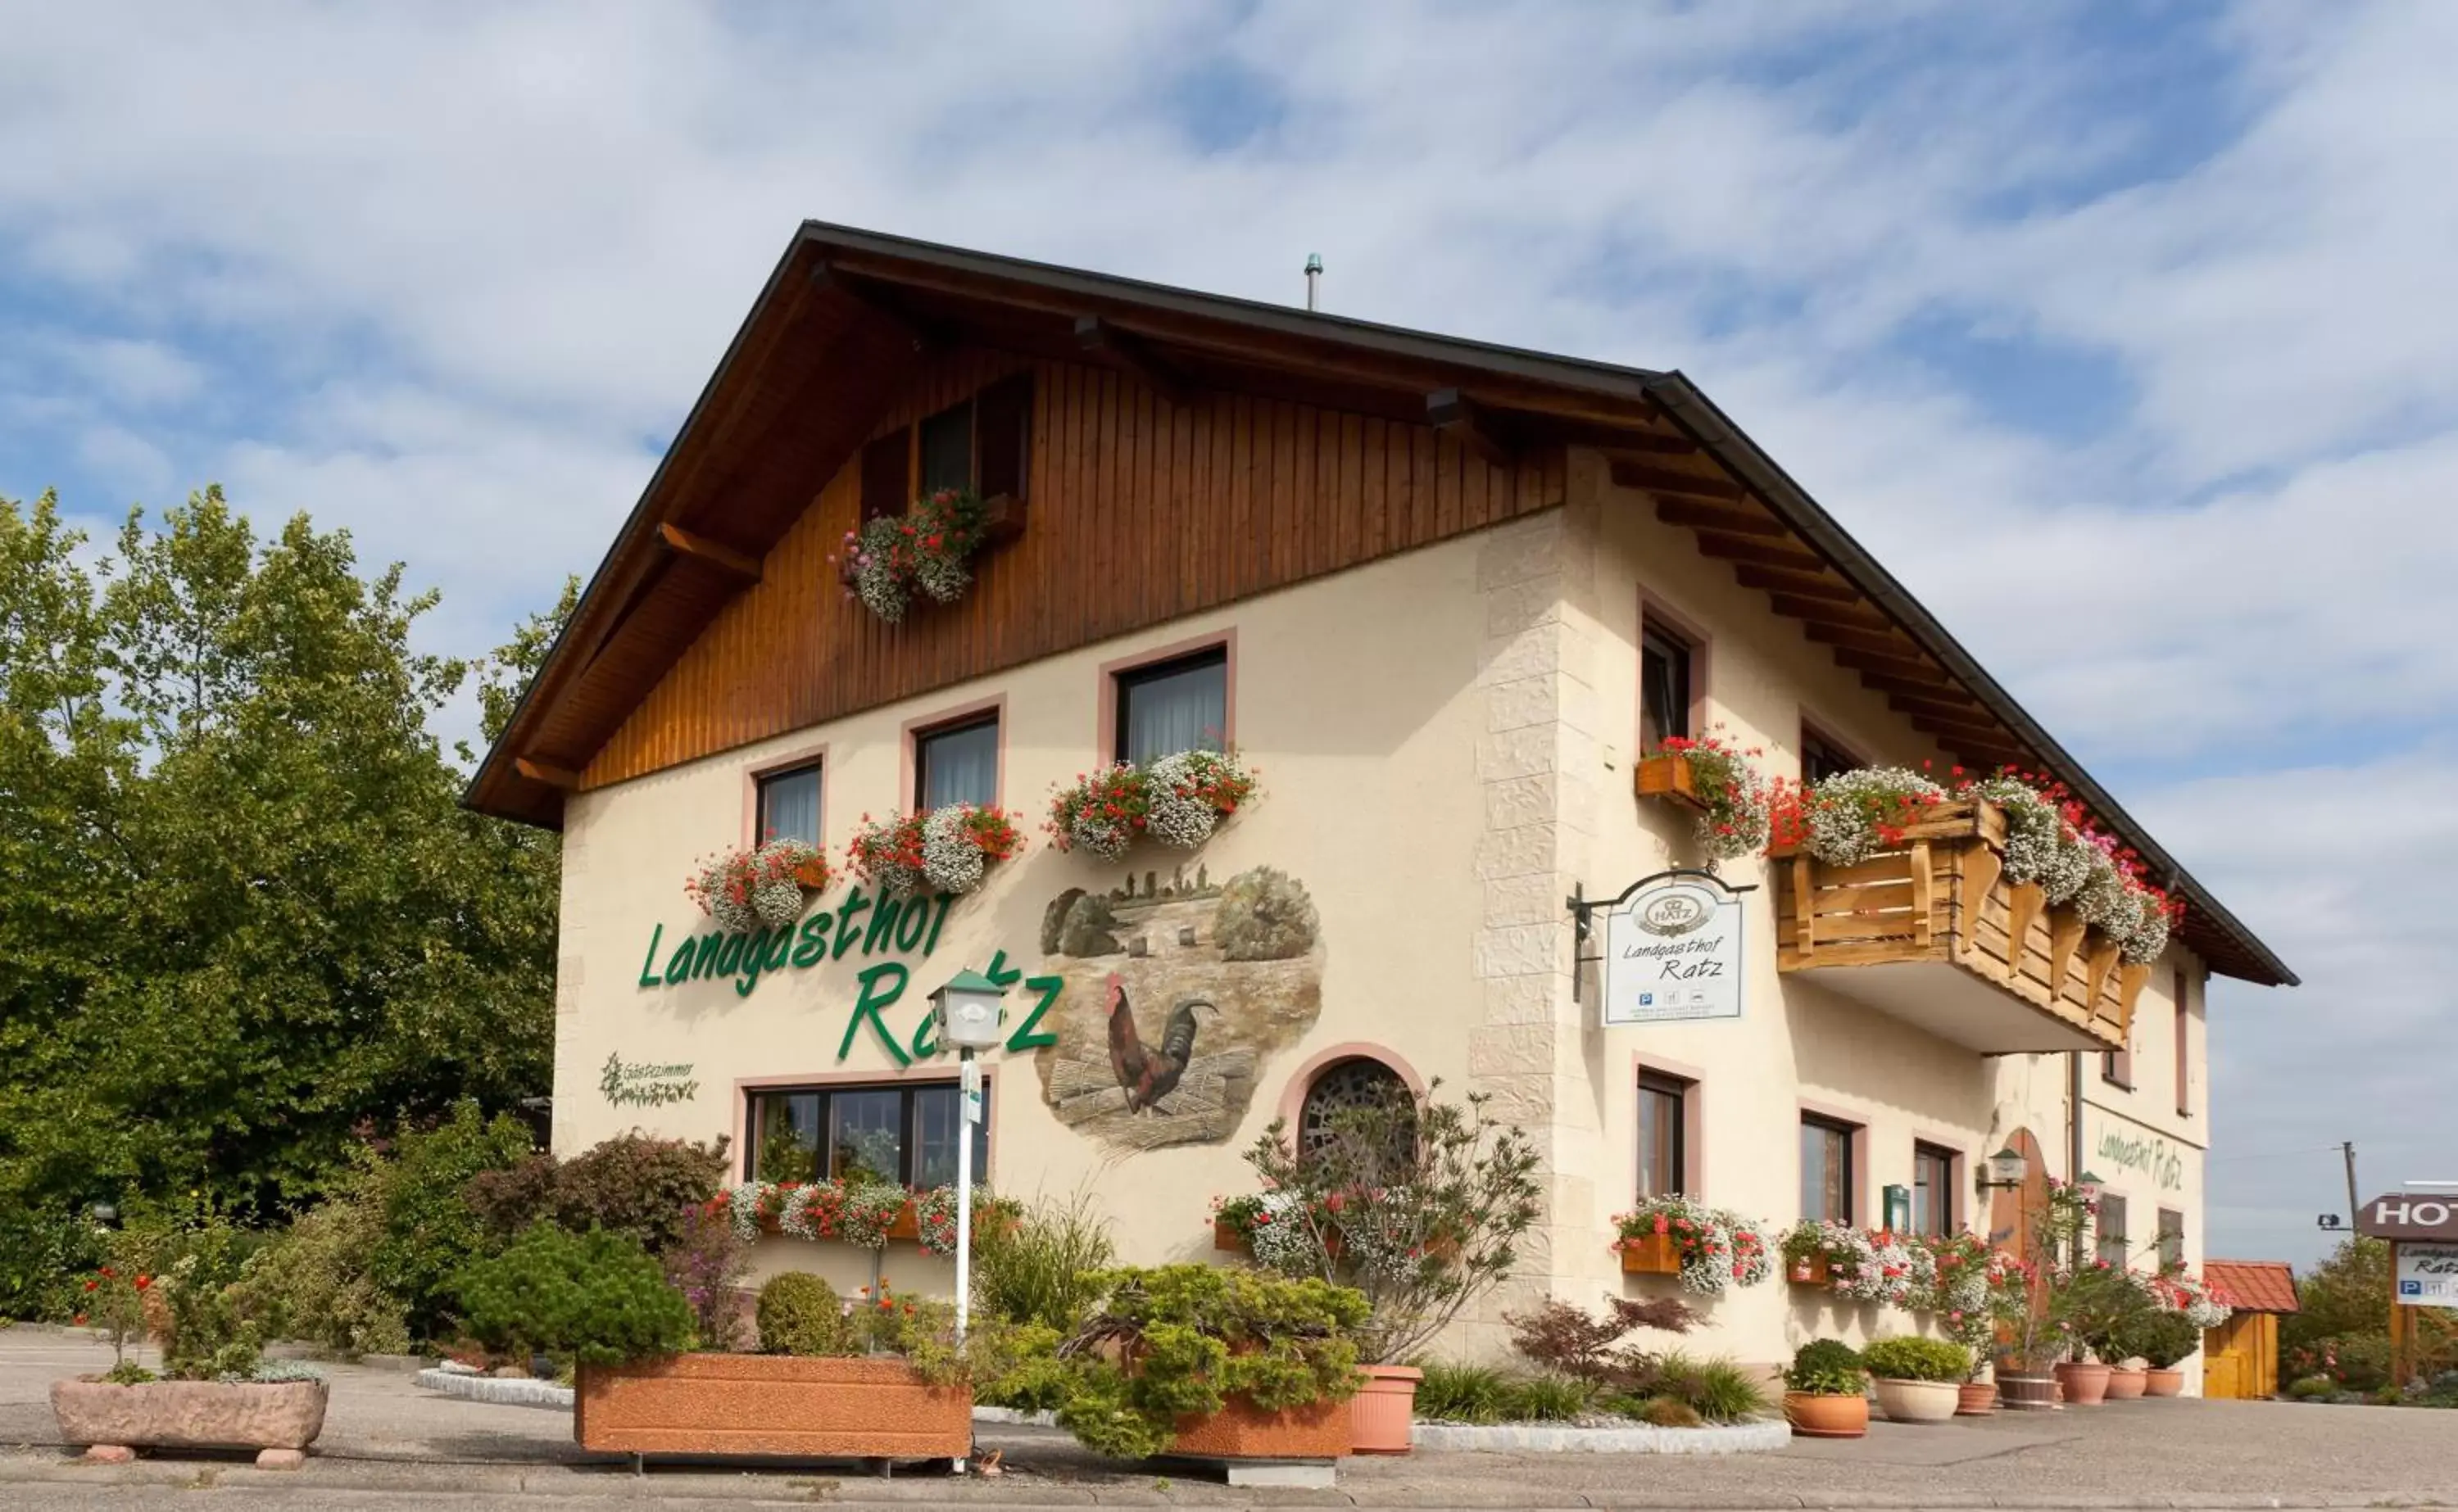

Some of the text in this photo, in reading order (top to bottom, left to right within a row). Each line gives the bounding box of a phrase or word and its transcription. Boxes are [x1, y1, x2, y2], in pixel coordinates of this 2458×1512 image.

[1623, 937, 1724, 960] Landgasthof
[1659, 957, 1723, 980] Ratz
[2152, 1139, 2183, 1191] Ratz
